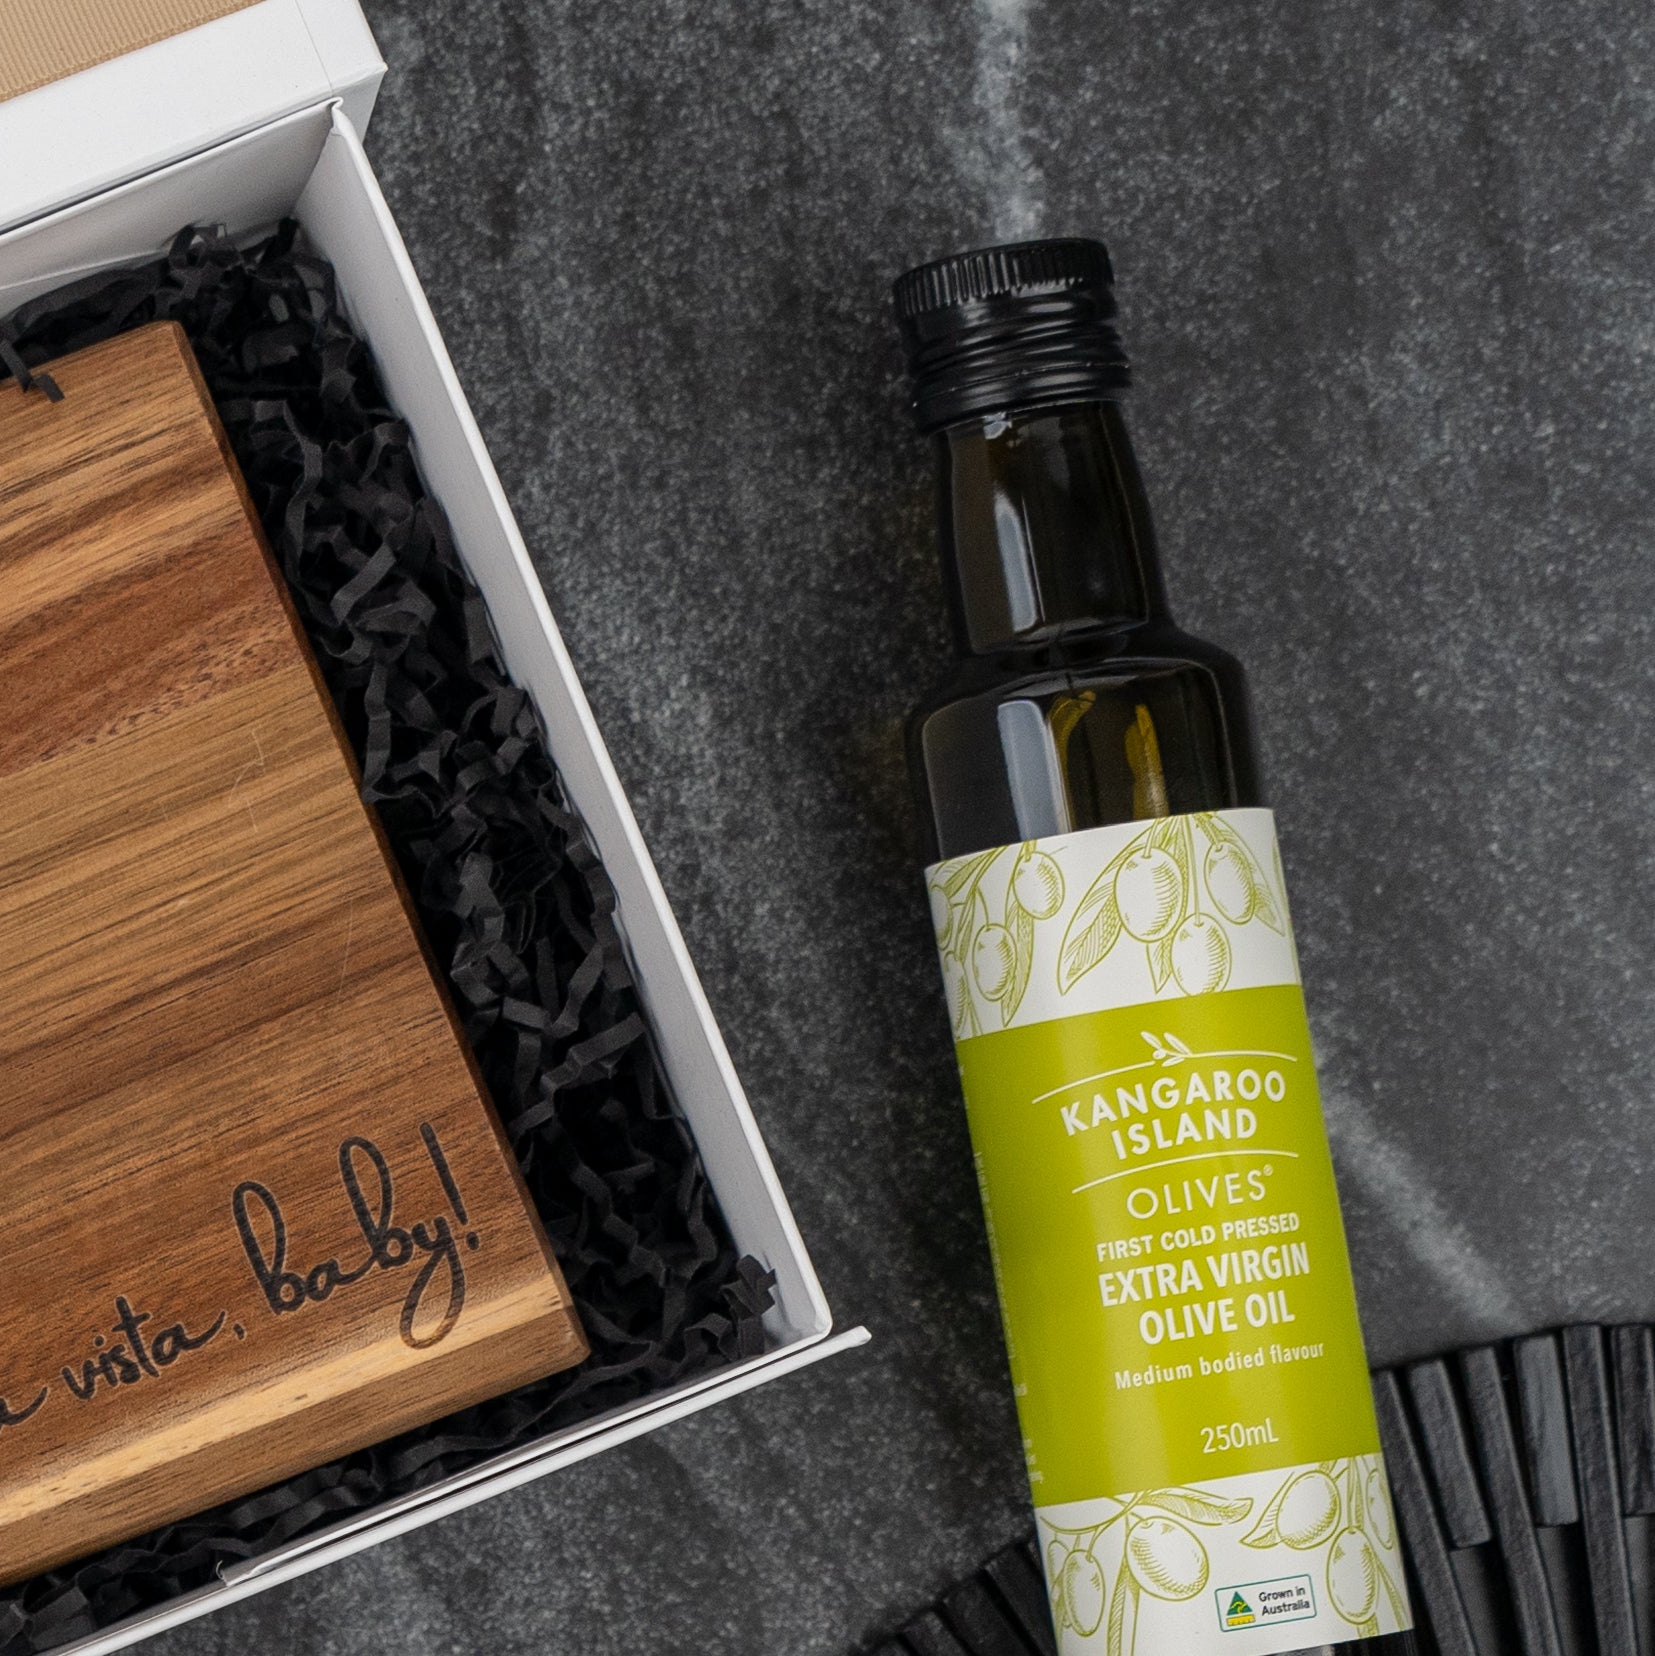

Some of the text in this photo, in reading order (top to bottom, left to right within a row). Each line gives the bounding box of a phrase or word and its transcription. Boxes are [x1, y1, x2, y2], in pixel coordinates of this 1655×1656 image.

[1059, 1068, 1286, 1137] KANGAROO
[1111, 1107, 1258, 1161] ISLAND
[230, 1121, 481, 1350] baby!
[1096, 1211, 1301, 1263] FIRST COLD PRESSED
[1098, 1241, 1311, 1308] EXTRA VIRGIN
[1138, 1289, 1296, 1346] OLIVE OIL
[1114, 1342, 1325, 1391] Medium bodied flavour
[1200, 1417, 1280, 1455] 250mL
[1258, 1586, 1306, 1602] Grown in
[1261, 1599, 1310, 1617] Australia
